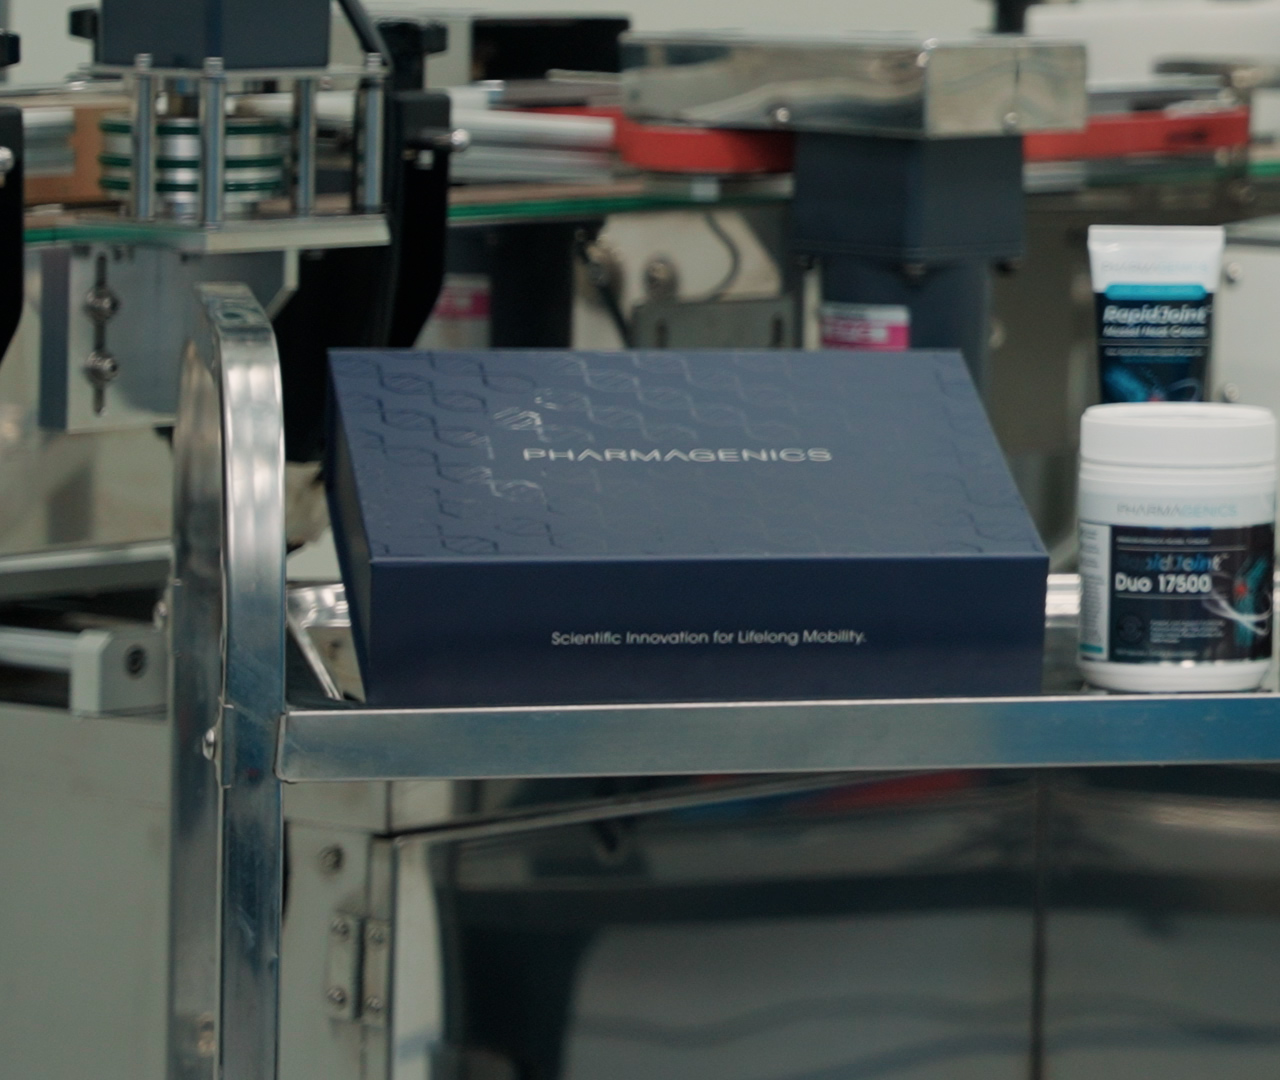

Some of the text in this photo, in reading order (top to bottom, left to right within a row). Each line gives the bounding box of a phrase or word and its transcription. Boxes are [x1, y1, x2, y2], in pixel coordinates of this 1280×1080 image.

[523, 447, 833, 463] PHARMAGENICS
[1116, 503, 1238, 518] PHARMAGENICS
[1114, 573, 1213, 593] Duo 17500
[551, 629, 867, 646] Scientific Innovation for Lifelong Mobility.
